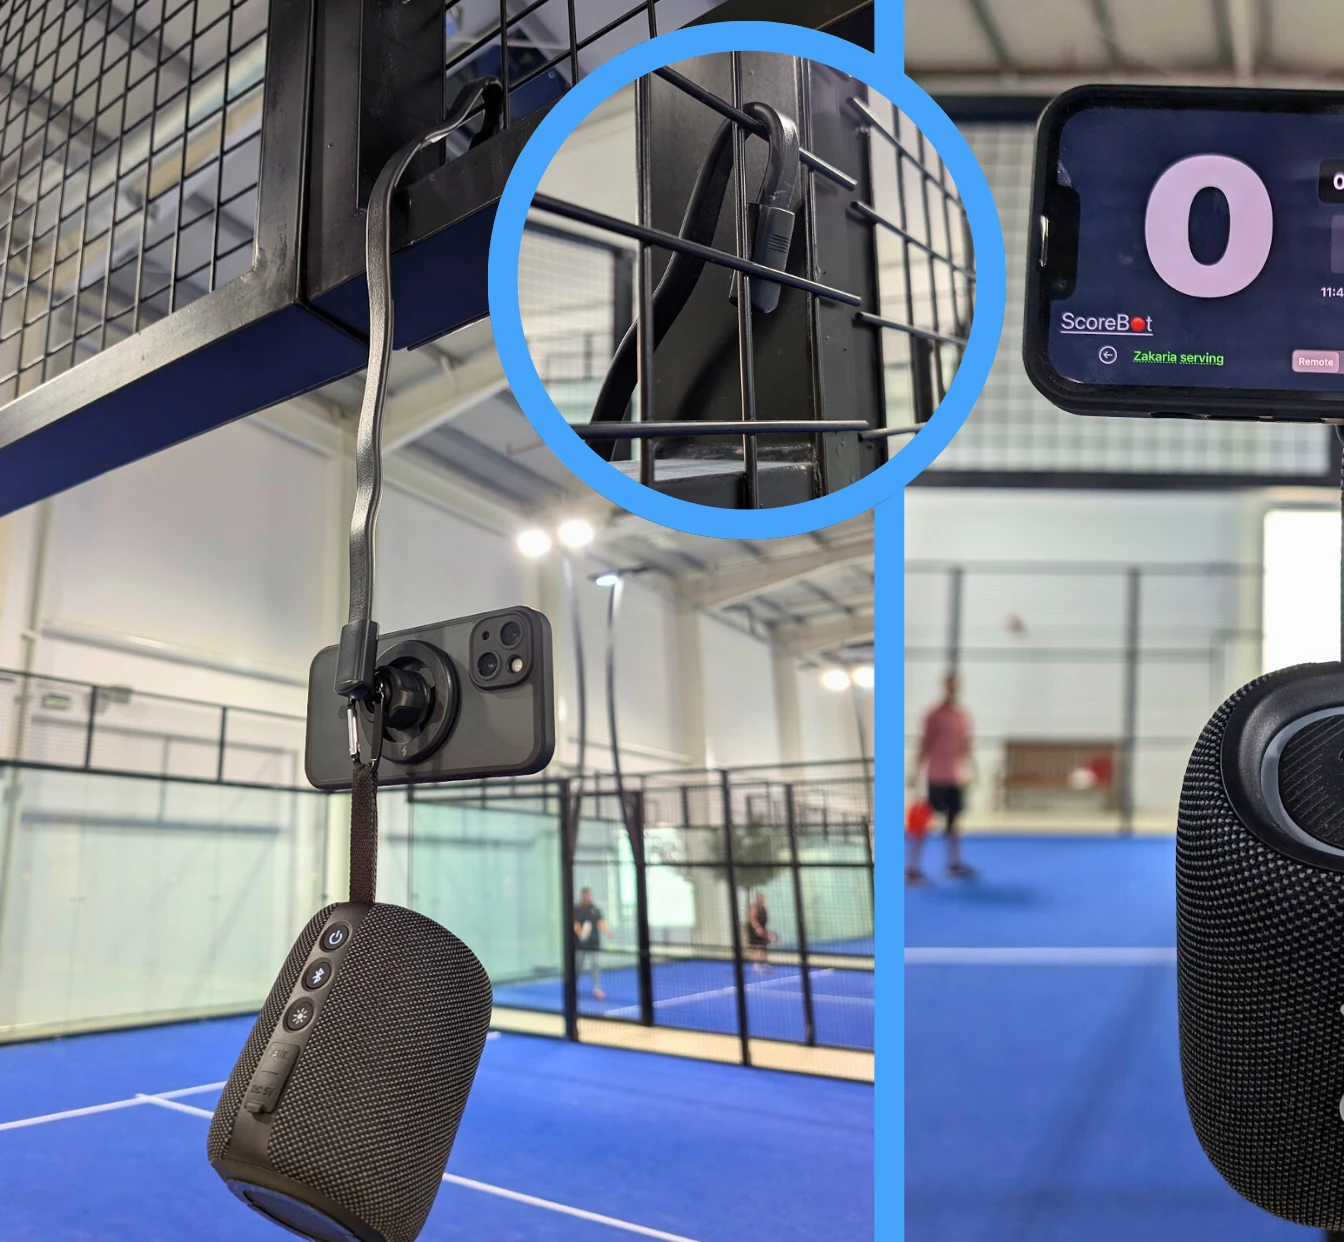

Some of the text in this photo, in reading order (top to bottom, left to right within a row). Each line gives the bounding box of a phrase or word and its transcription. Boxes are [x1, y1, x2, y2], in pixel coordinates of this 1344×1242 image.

[1145, 154, 1273, 298] 0
[1133, 350, 1225, 366] Zakaria serving
[1298, 357, 1334, 367] Remote
